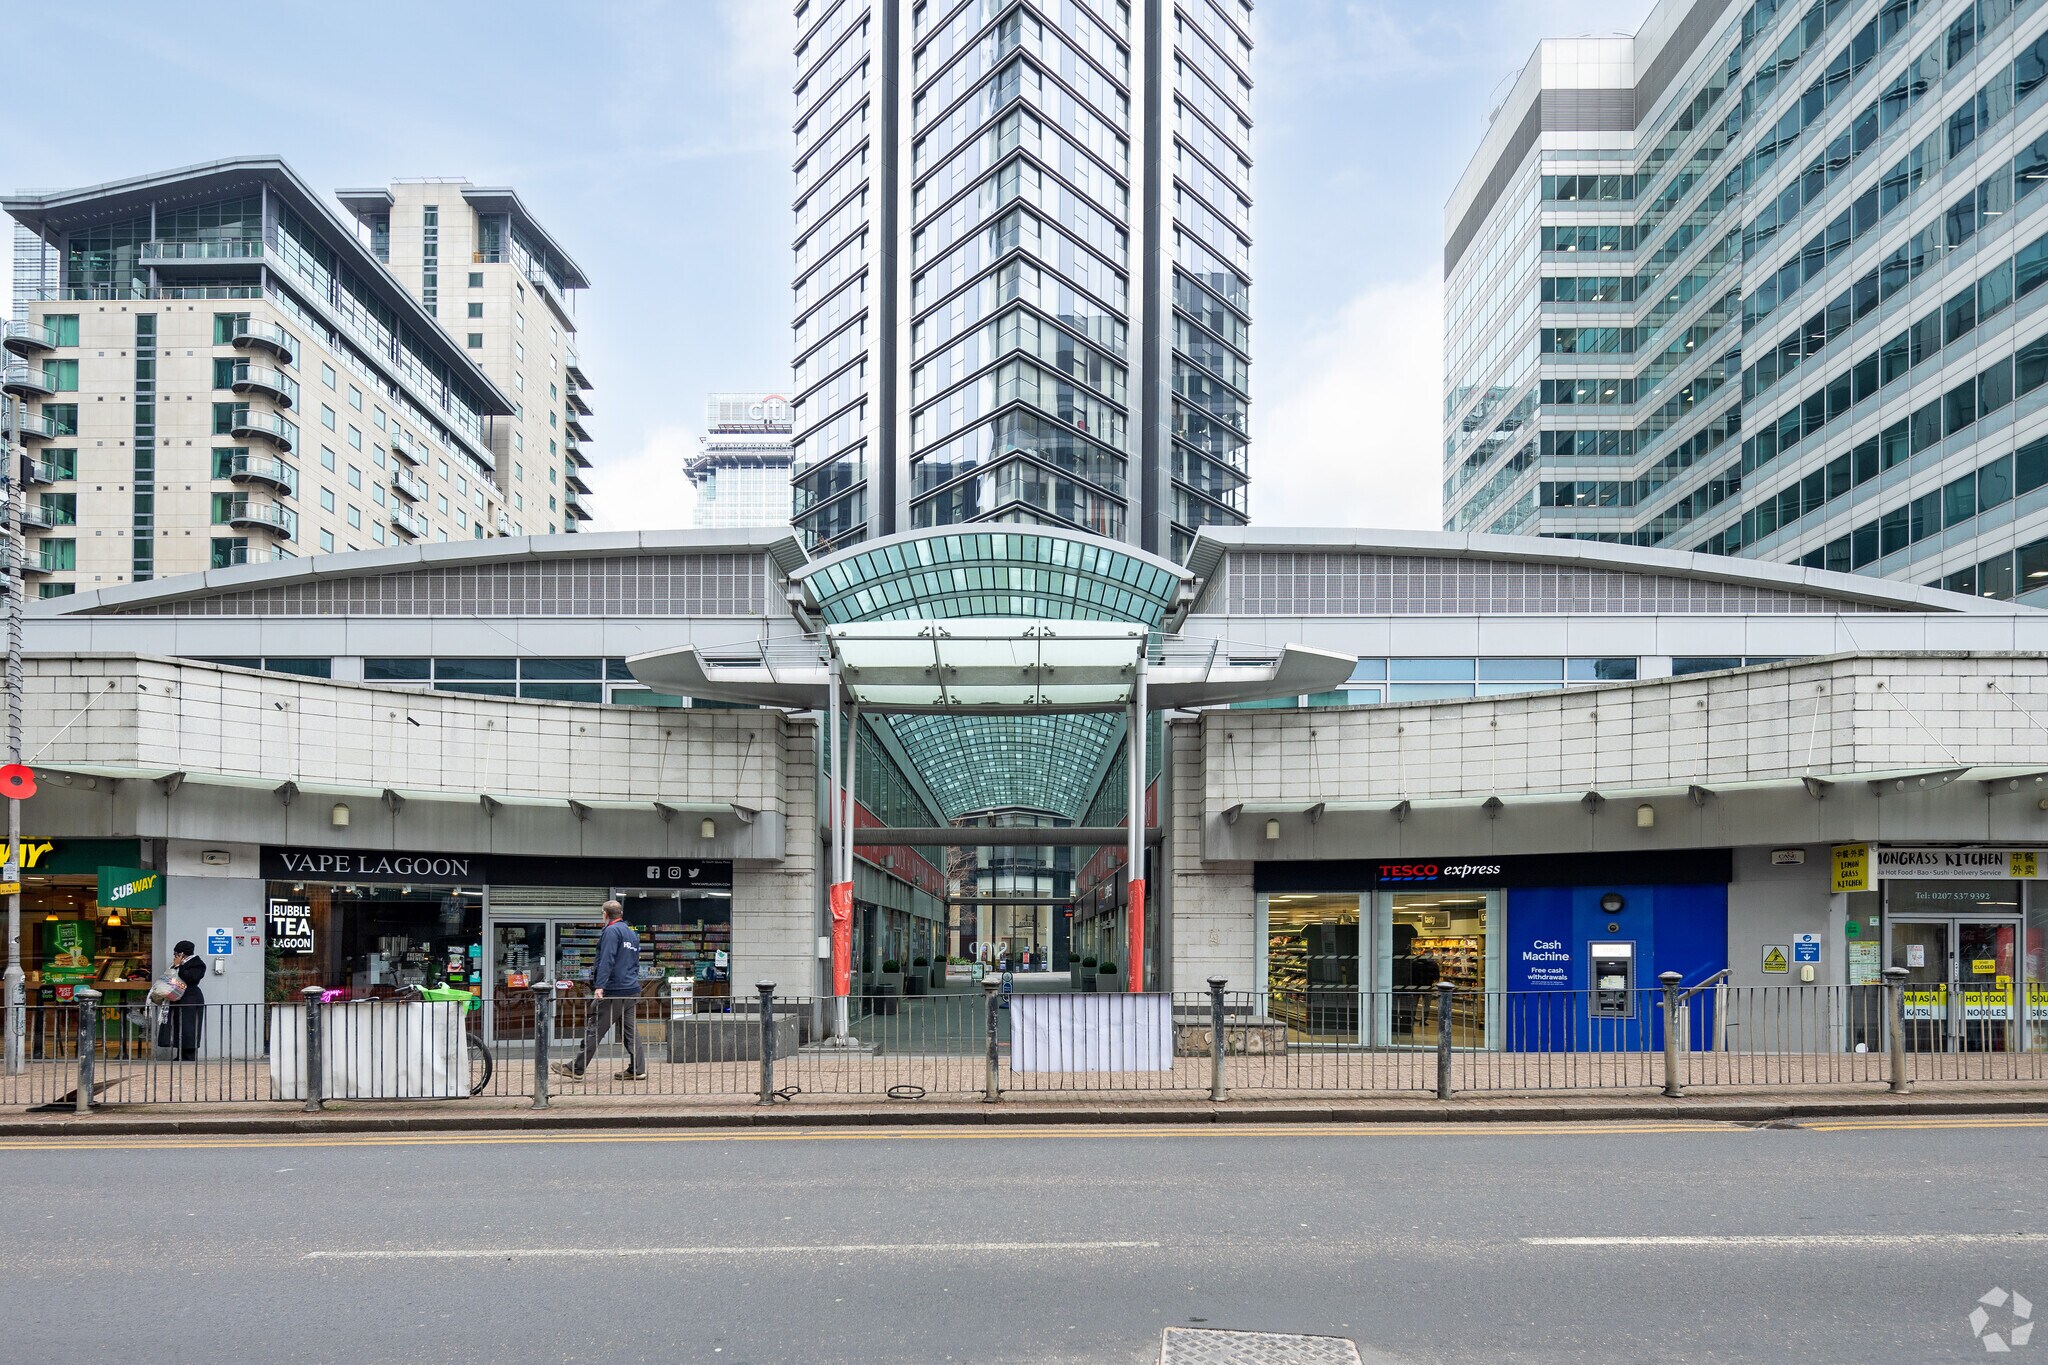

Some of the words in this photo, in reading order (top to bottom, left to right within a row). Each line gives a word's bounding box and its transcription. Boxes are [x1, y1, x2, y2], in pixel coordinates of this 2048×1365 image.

[749, 395, 787, 421] citi
[280, 853, 351, 873] VAPE
[358, 855, 470, 877] LAGOON
[1840, 860, 1860, 870] LEMON
[1945, 852, 2003, 866] KITCHEN
[1379, 865, 1438, 876] TESCO
[1443, 864, 1501, 878] express
[1841, 870, 1859, 878] GRASS
[111, 874, 157, 901] SUBWAY
[1838, 879, 1863, 888] KITCHEN
[1915, 891, 1931, 900] Tel:
[1932, 892, 1951, 900] 0207
[1954, 892, 1969, 900] 537
[1970, 892, 1990, 900] 9392
[274, 905, 310, 917] BUBBLE
[274, 918, 311, 936] TEA
[274, 938, 310, 948] LAGOON
[1534, 940, 1562, 950] Cash
